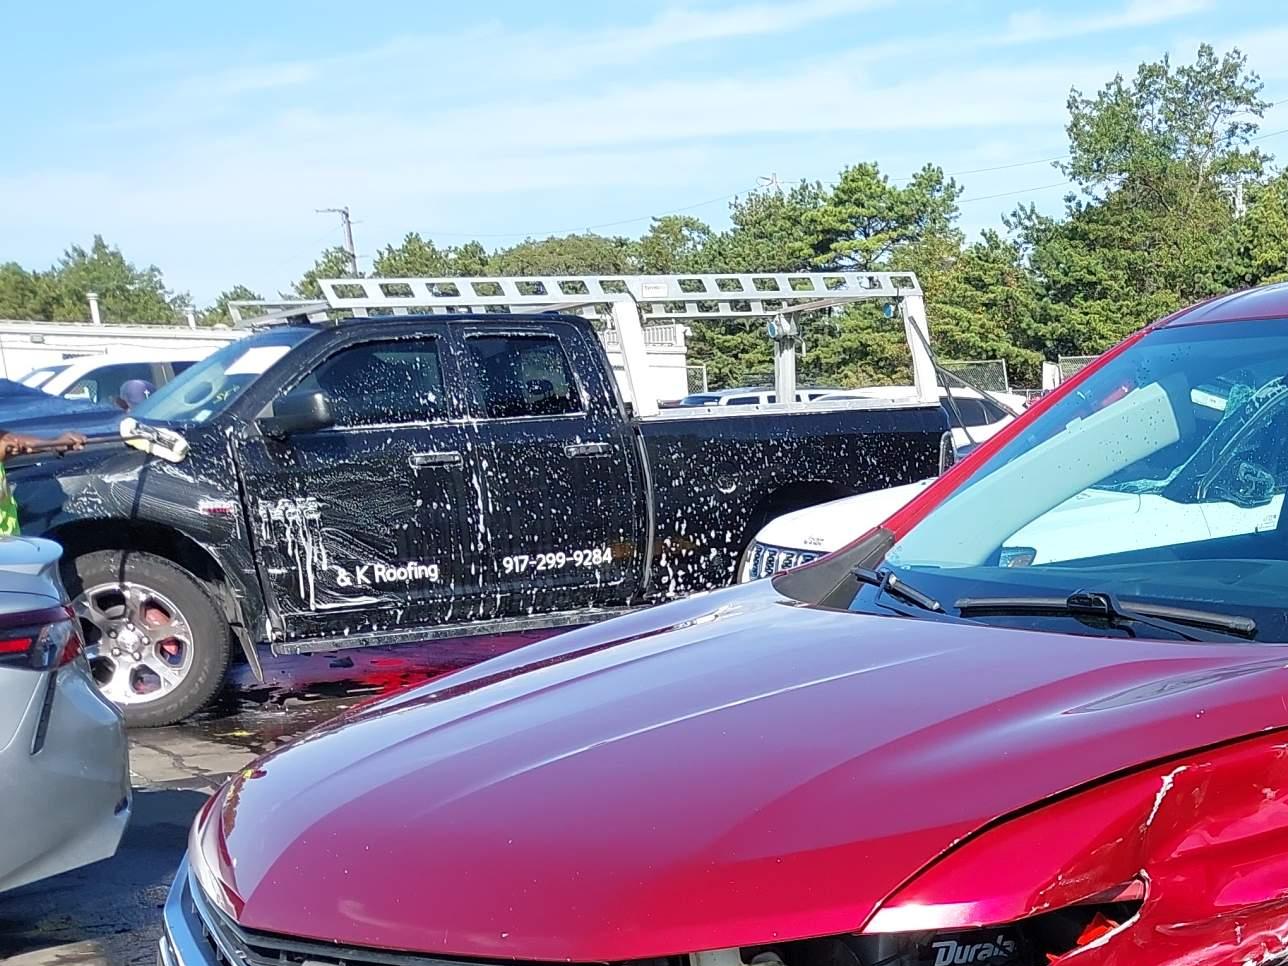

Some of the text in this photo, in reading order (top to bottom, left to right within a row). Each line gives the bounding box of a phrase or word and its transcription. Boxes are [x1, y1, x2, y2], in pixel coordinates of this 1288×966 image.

[502, 547, 613, 574] 917-299-9284
[336, 561, 439, 587] & K Roofing
